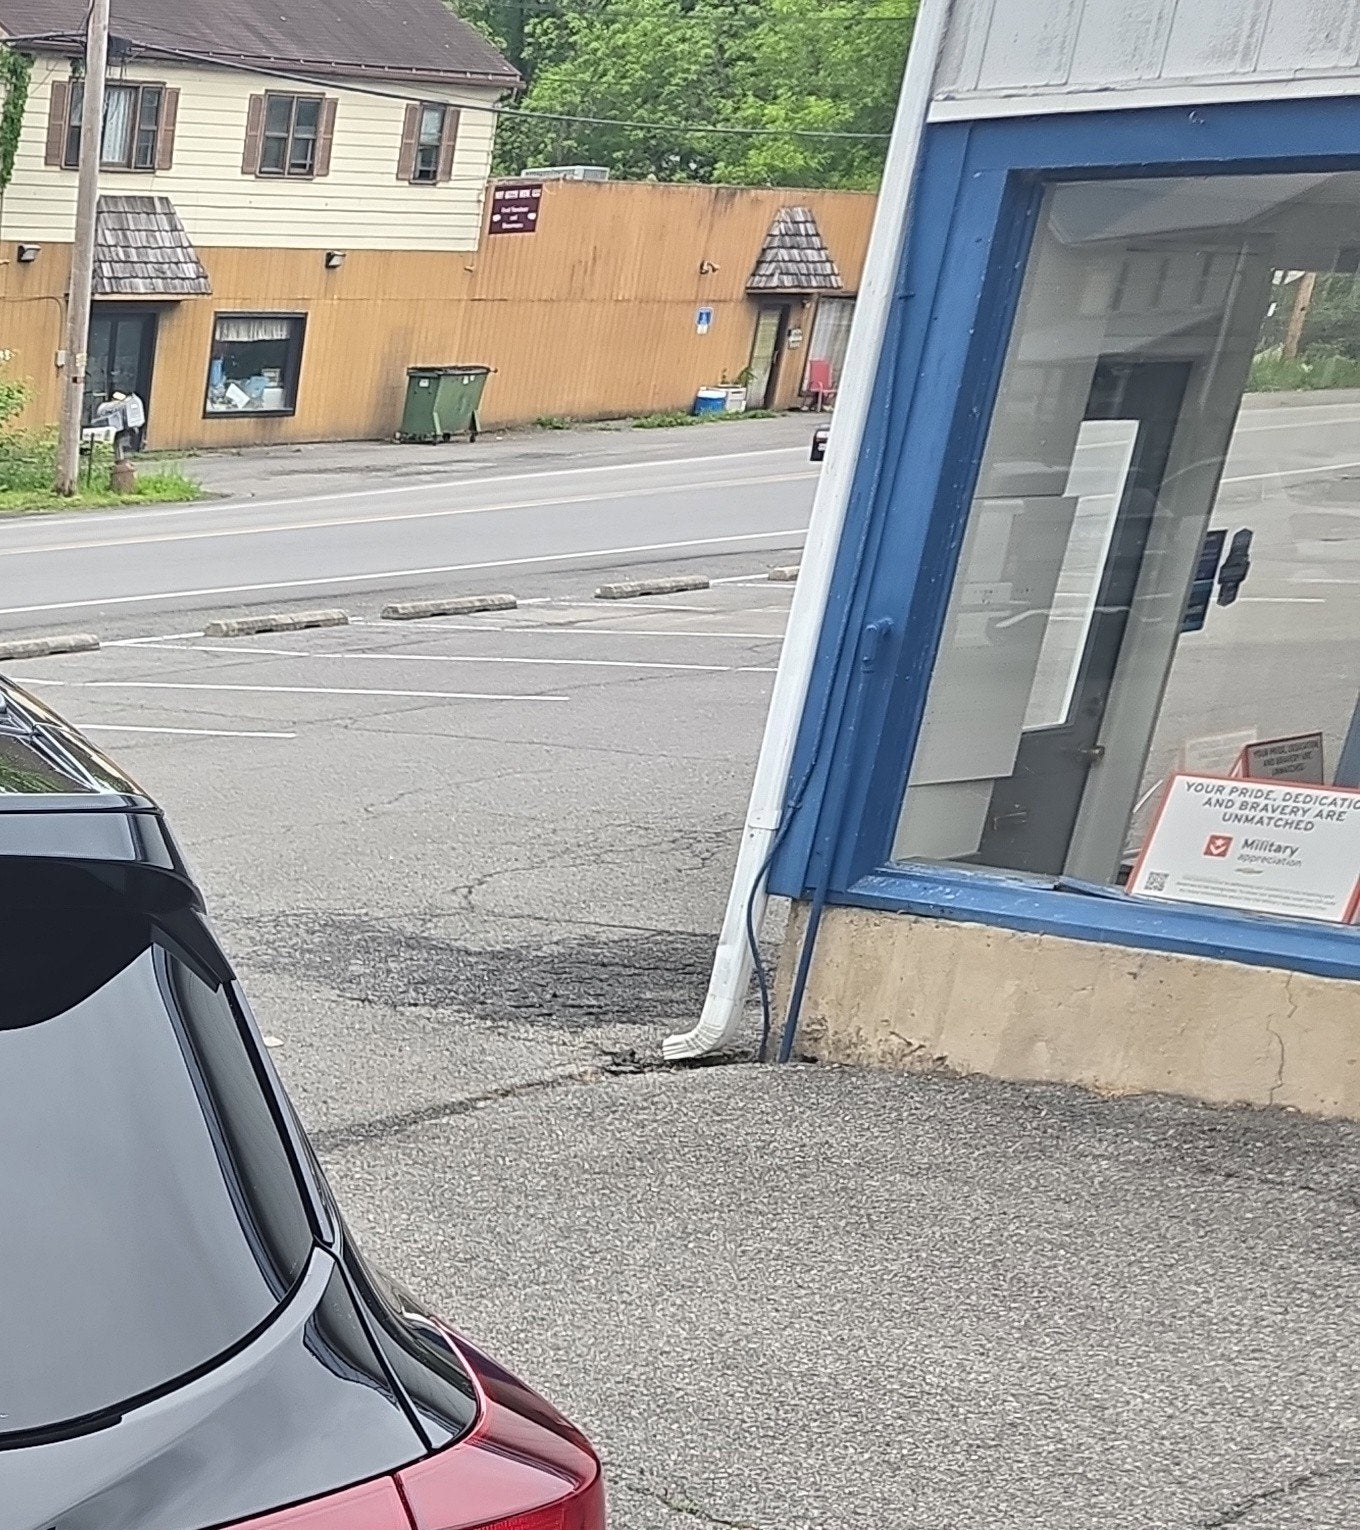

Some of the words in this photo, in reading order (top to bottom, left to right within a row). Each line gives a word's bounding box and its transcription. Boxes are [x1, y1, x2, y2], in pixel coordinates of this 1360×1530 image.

[1185, 781, 1226, 794] YOUR
[1228, 786, 1278, 801] PRIDE,
[1202, 797, 1235, 810] AND
[1238, 800, 1311, 819] BRAVERY
[1313, 808, 1348, 823] ARE
[1221, 811, 1315, 832] UNMATCHED
[1241, 837, 1300, 857] Military
[1236, 853, 1303, 868] appreciation
